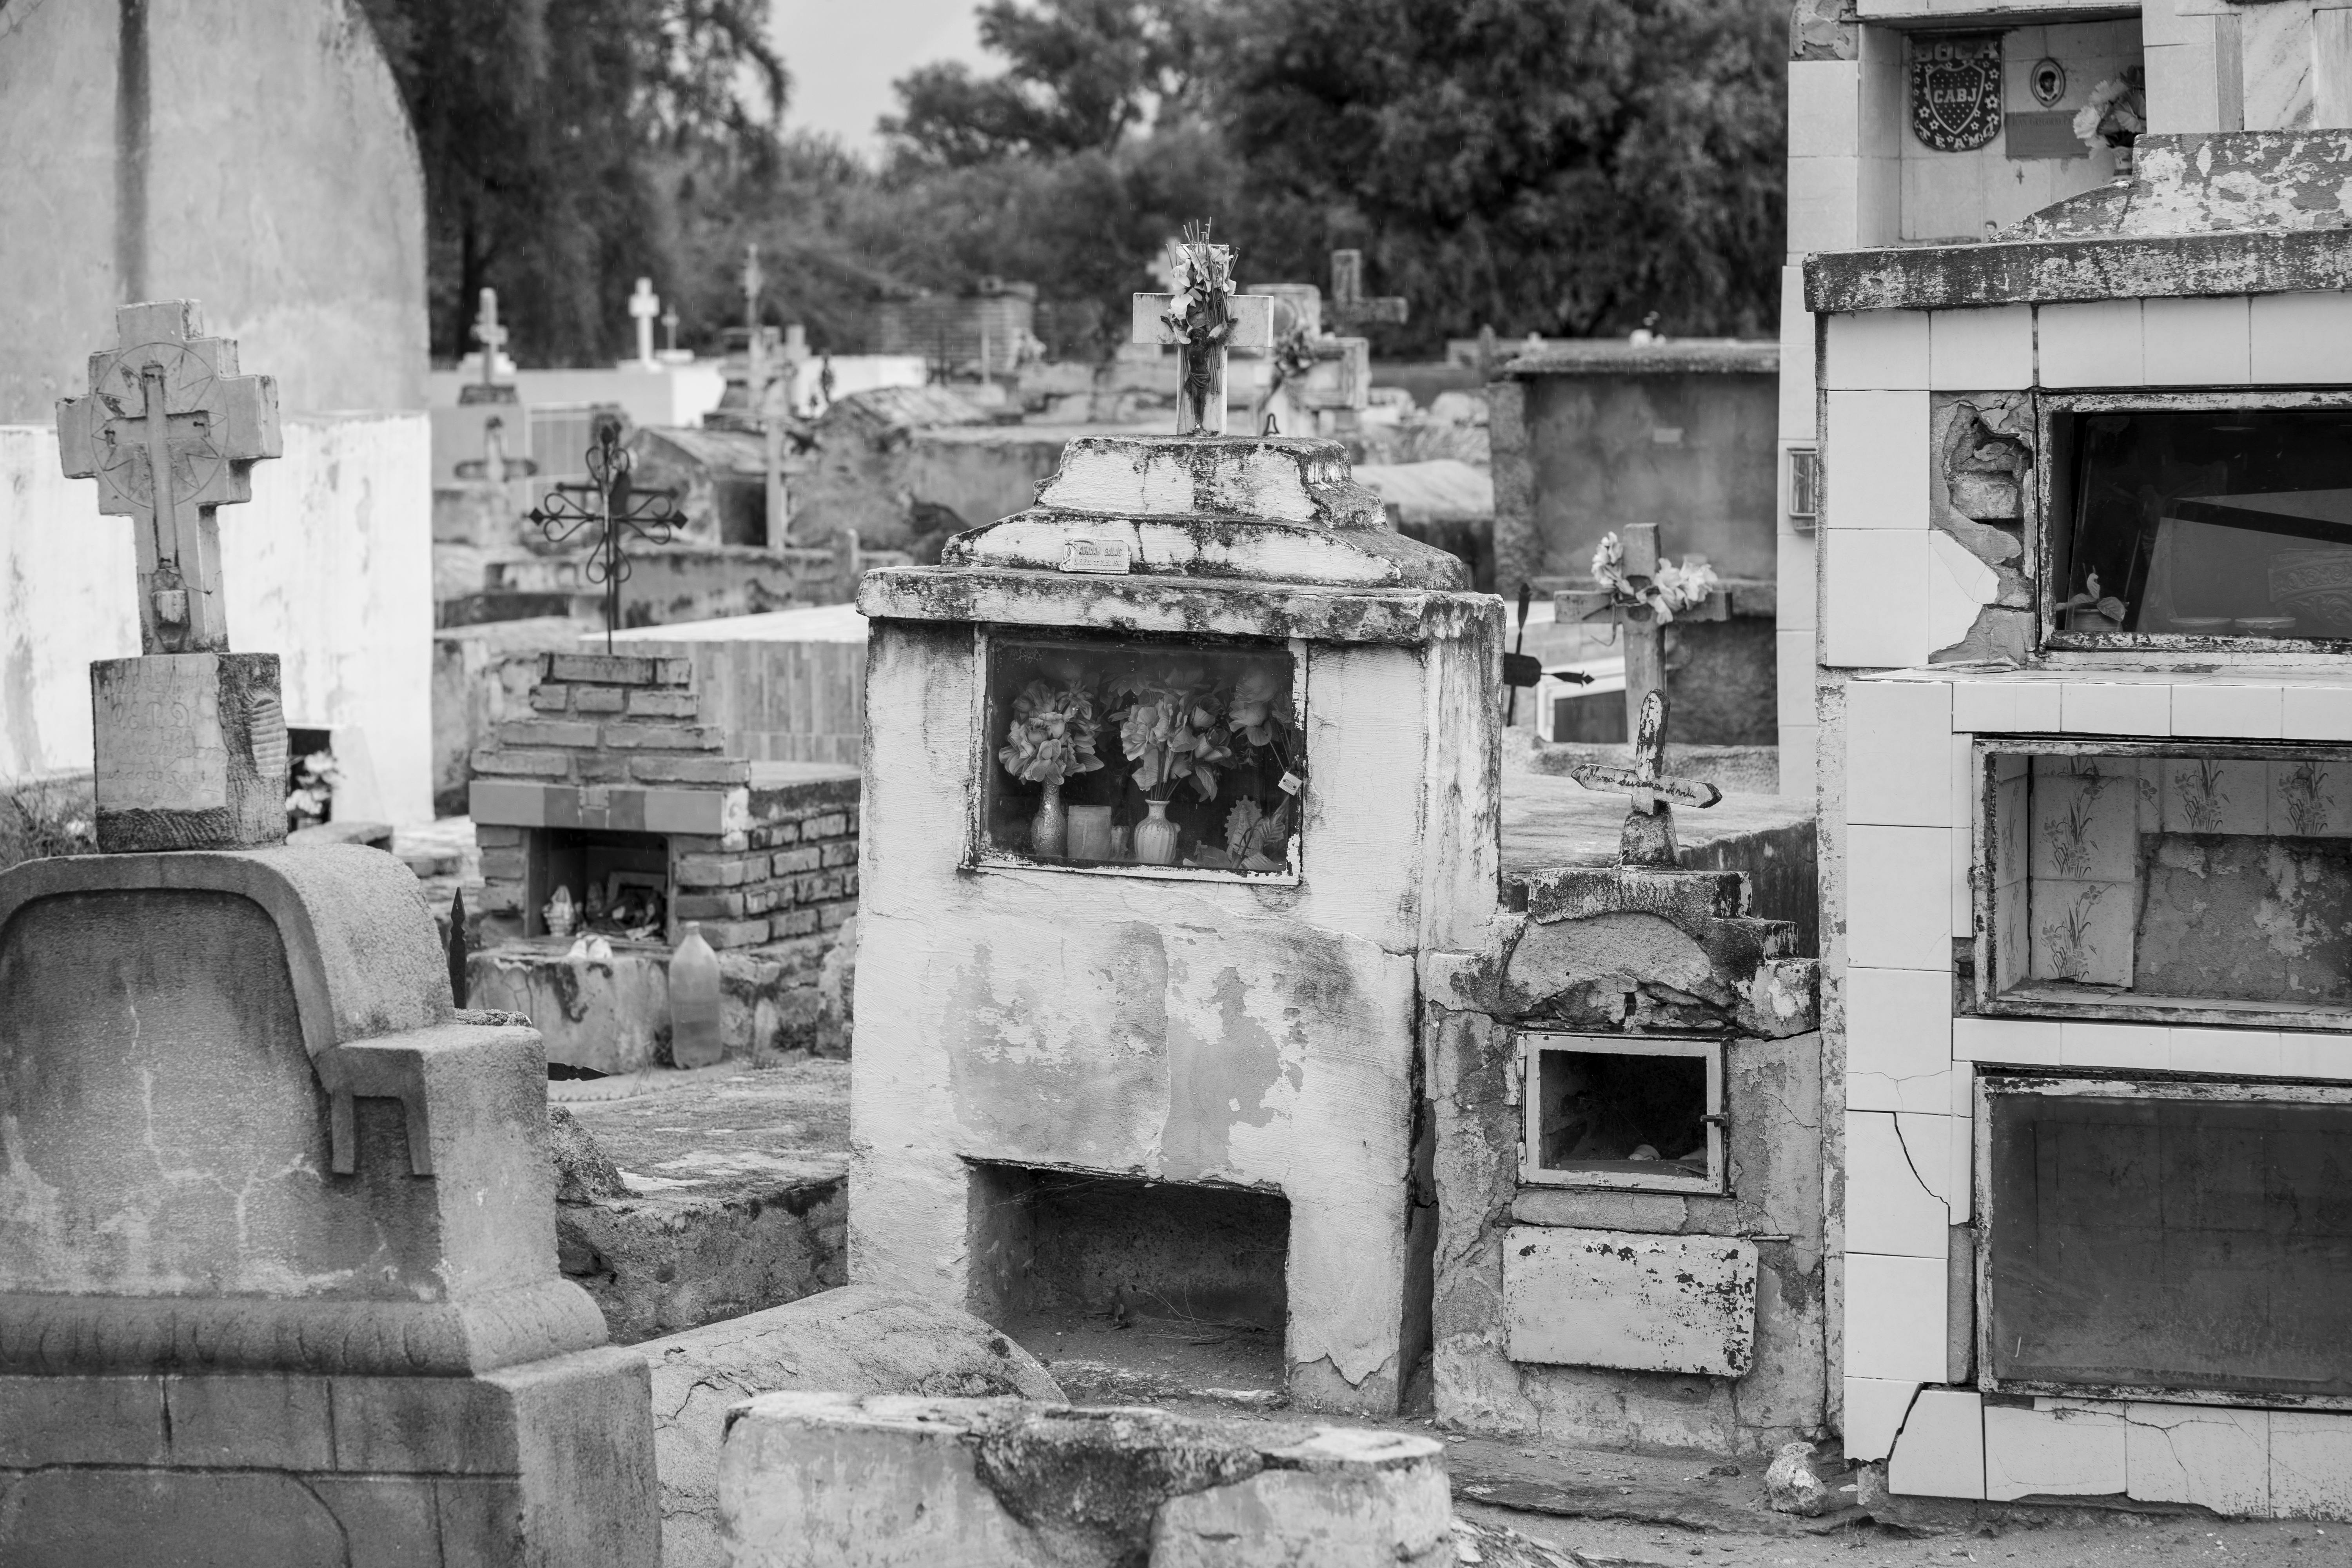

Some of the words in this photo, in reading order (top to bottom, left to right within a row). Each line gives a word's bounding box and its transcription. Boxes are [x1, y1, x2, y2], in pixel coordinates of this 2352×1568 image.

[1914, 40, 1999, 62] BOCA
[1934, 87, 1977, 103] CABJ
[1918, 122, 1945, 149] TE
[1953, 122, 1994, 149] AMO
[1104, 546, 1122, 557] SALAS
